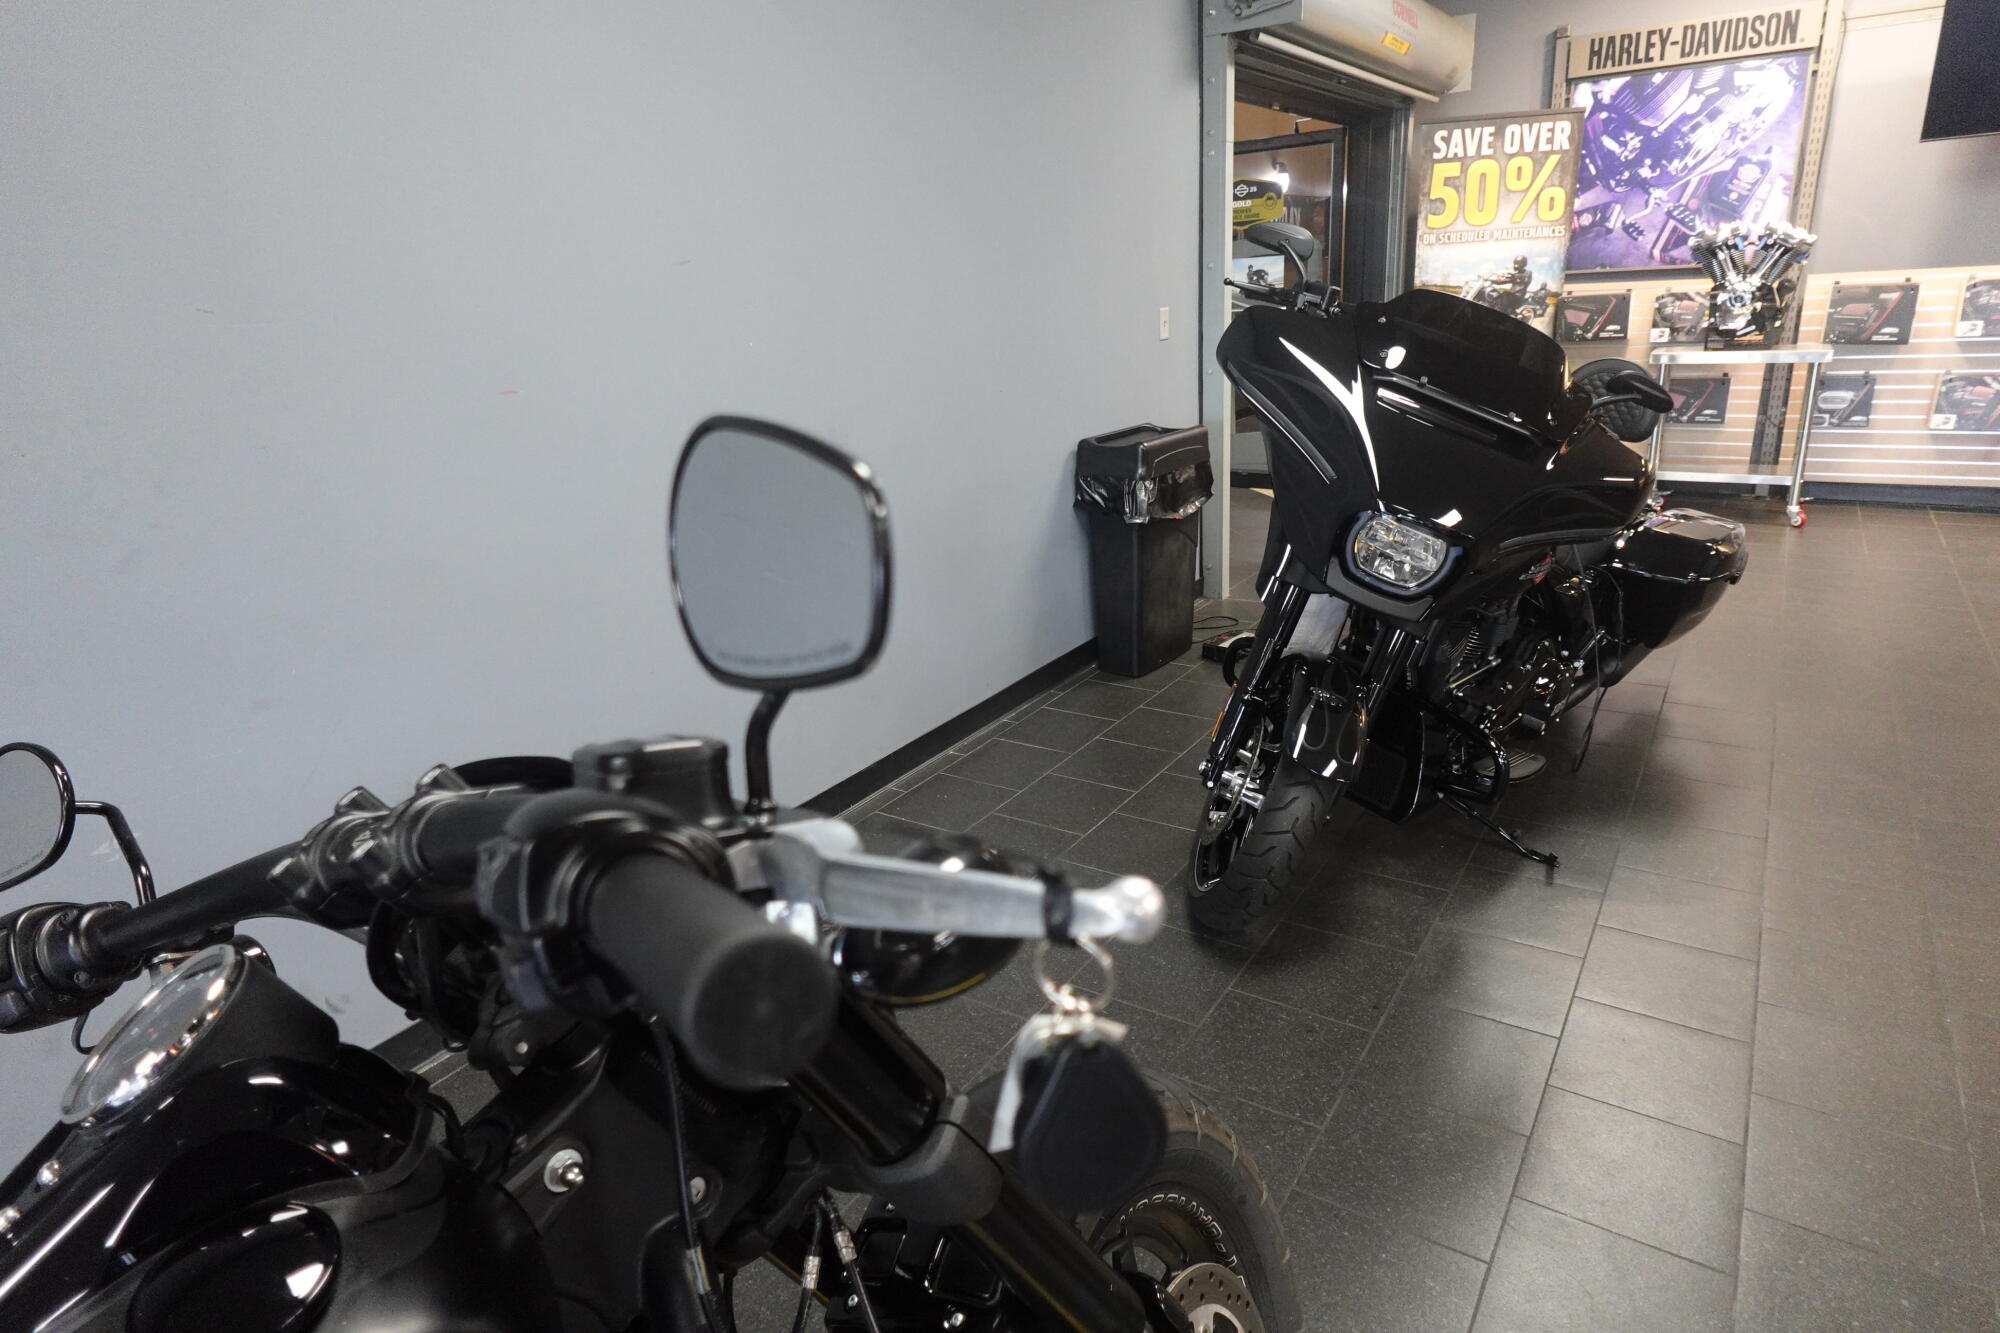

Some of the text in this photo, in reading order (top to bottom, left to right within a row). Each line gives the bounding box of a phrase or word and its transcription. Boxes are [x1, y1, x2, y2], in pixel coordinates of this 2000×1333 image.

[1587, 9, 1801, 71] HARLEY-DAVIDSON
[1432, 120, 1572, 160] SAVE OVER
[1425, 153, 1567, 230] 50%
[1422, 225, 1567, 245] ON SCHEDULED MAINTENANCES
